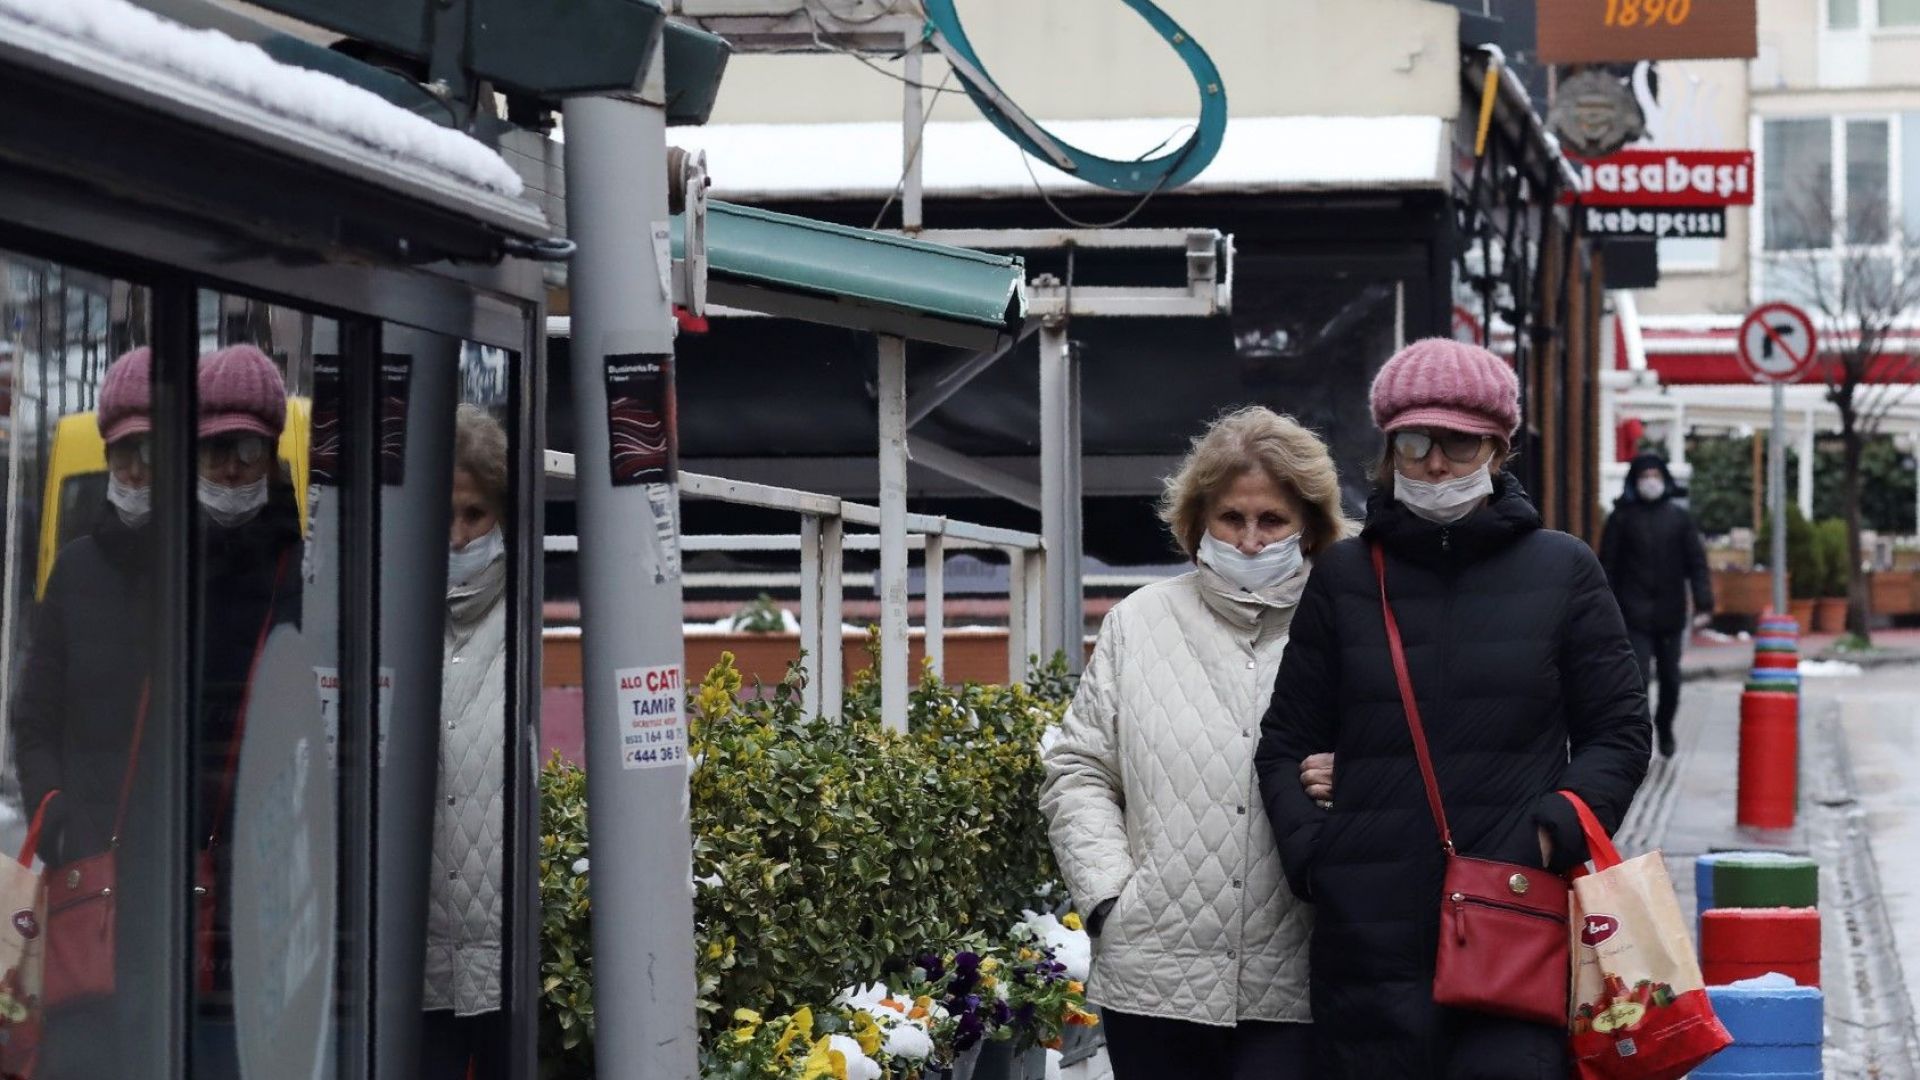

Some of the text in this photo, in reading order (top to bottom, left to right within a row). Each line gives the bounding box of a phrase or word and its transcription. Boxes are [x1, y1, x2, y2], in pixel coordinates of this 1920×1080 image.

[1605, 0, 1690, 27] 1890
[1586, 207, 1721, 237] kebapçısı
[621, 669, 680, 694] ALO ÇATI
[633, 693, 676, 716] TAMİR
[634, 749, 657, 763] 444
